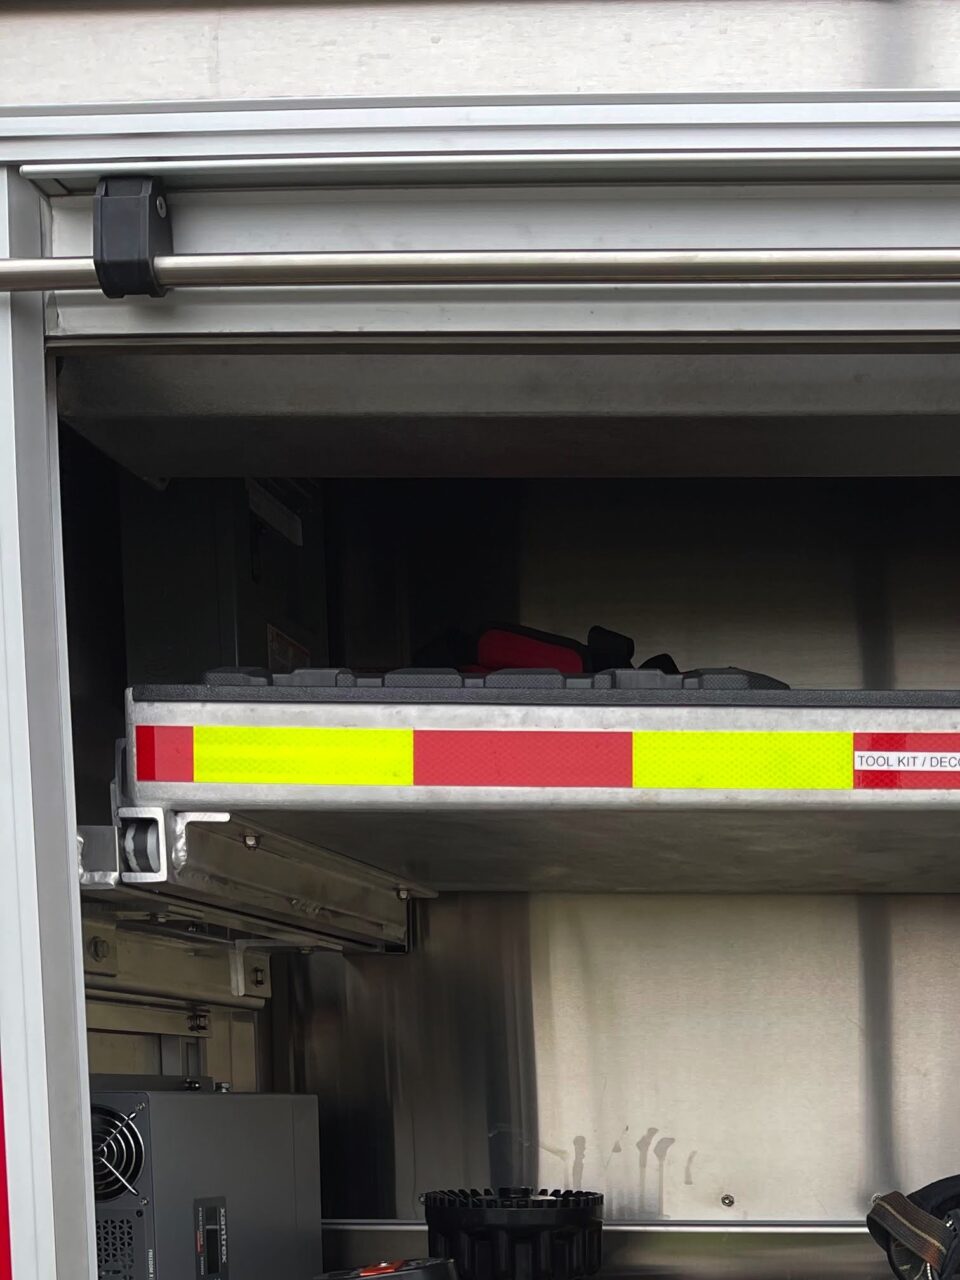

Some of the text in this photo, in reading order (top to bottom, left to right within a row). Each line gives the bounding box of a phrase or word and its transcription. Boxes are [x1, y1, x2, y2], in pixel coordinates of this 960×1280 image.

[858, 755, 894, 768] TOOL
[897, 756, 919, 768] KIT
[220, 1207, 228, 1264] xantrex
